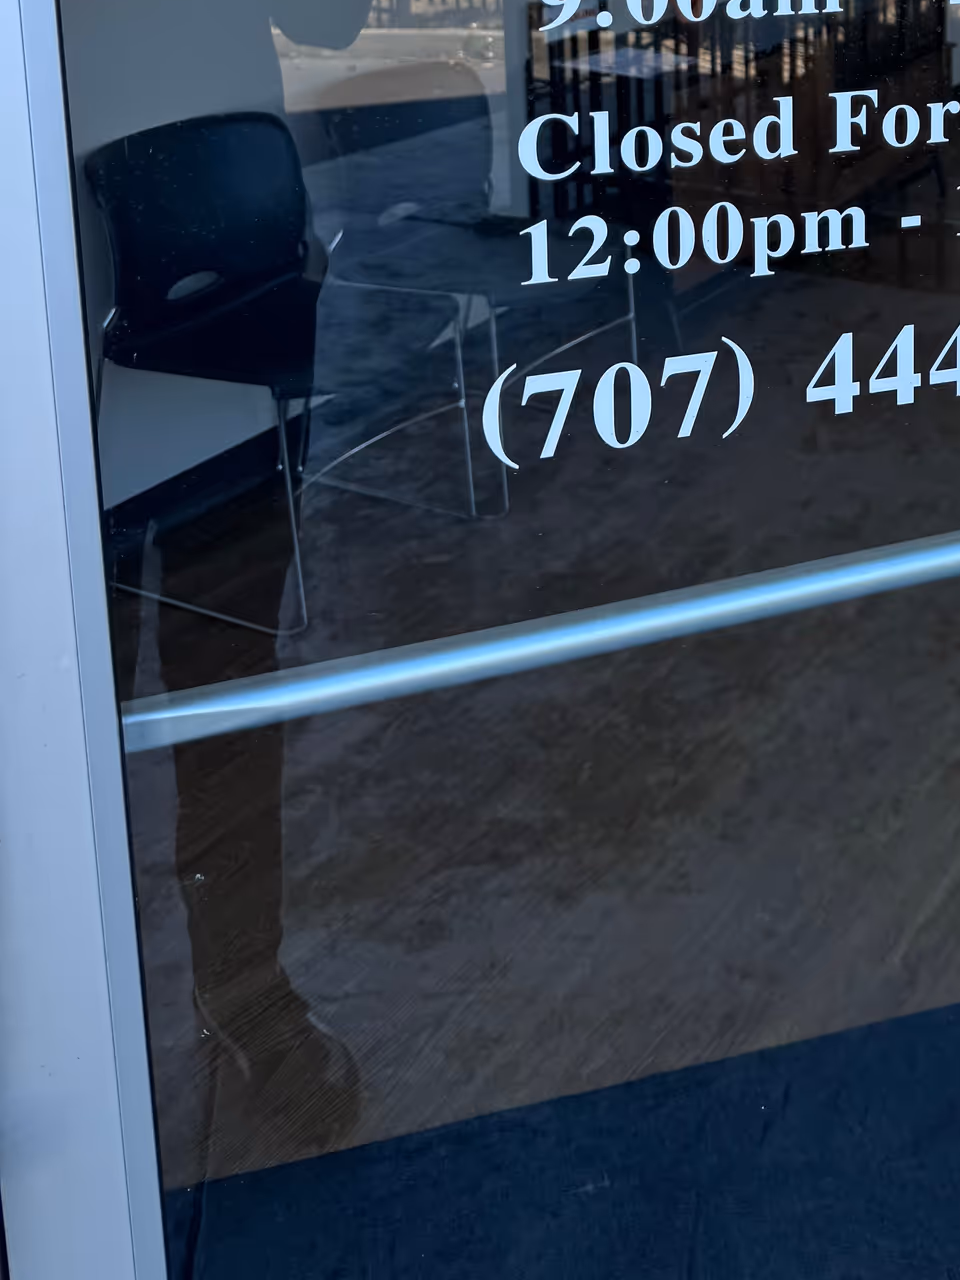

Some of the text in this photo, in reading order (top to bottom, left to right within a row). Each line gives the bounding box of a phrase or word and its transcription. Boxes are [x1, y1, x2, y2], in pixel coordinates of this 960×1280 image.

[517, 95, 798, 182] Closed
[828, 89, 960, 154] For
[518, 201, 870, 286] 12:00pm
[901, 214, 921, 230] -
[482, 336, 755, 470] (707)
